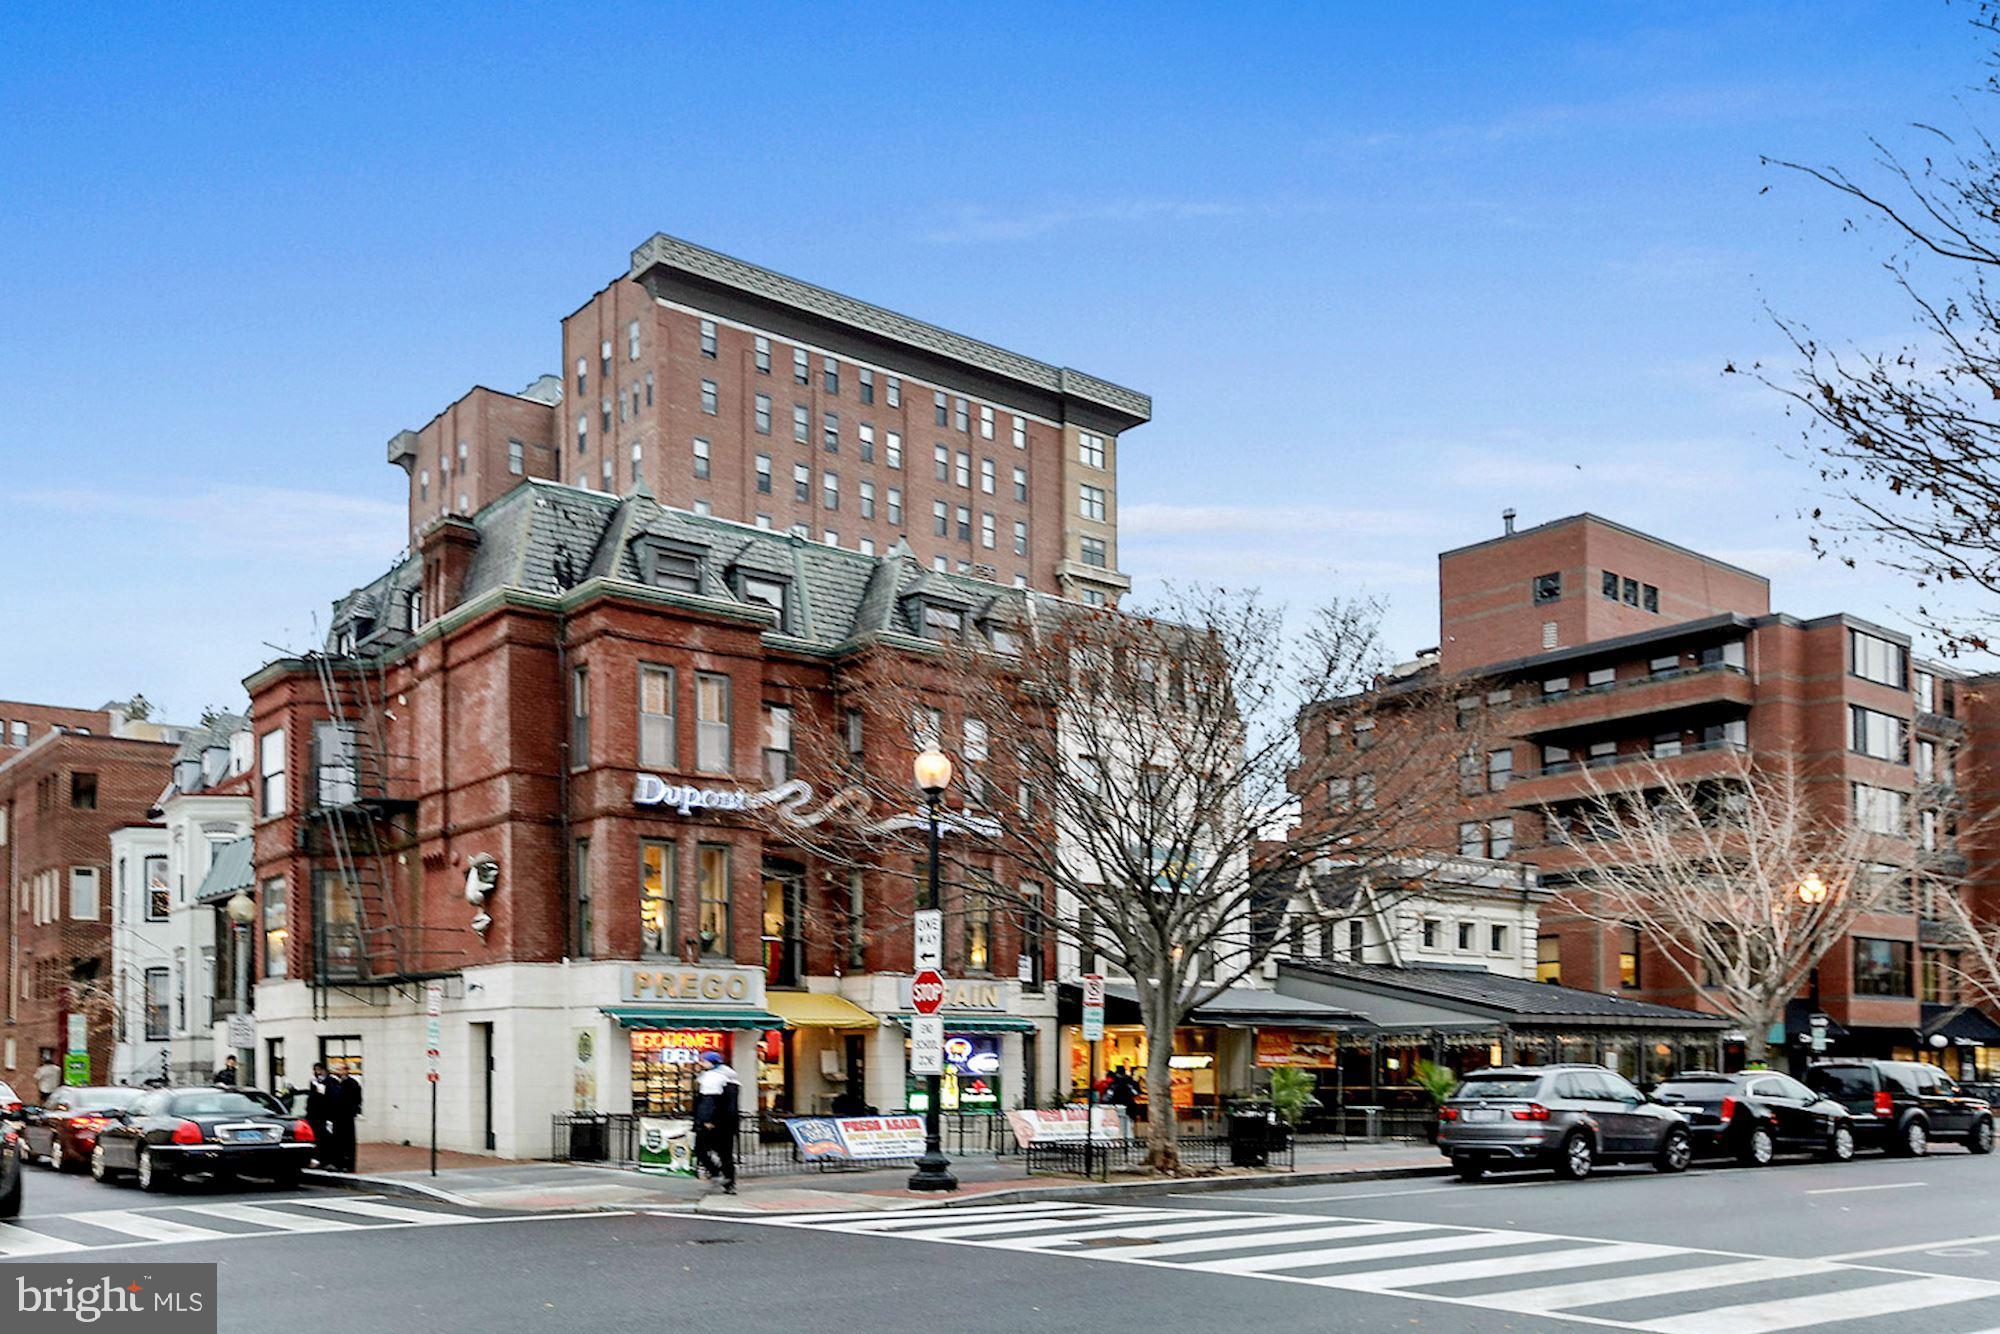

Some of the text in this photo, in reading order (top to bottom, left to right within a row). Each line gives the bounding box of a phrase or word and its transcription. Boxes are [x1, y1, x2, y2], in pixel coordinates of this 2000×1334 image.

[919, 918, 939, 931] ONE
[632, 971, 749, 1000] PREGO
[912, 982, 943, 1002] STOP
[639, 1031, 723, 1048] GOURMET
